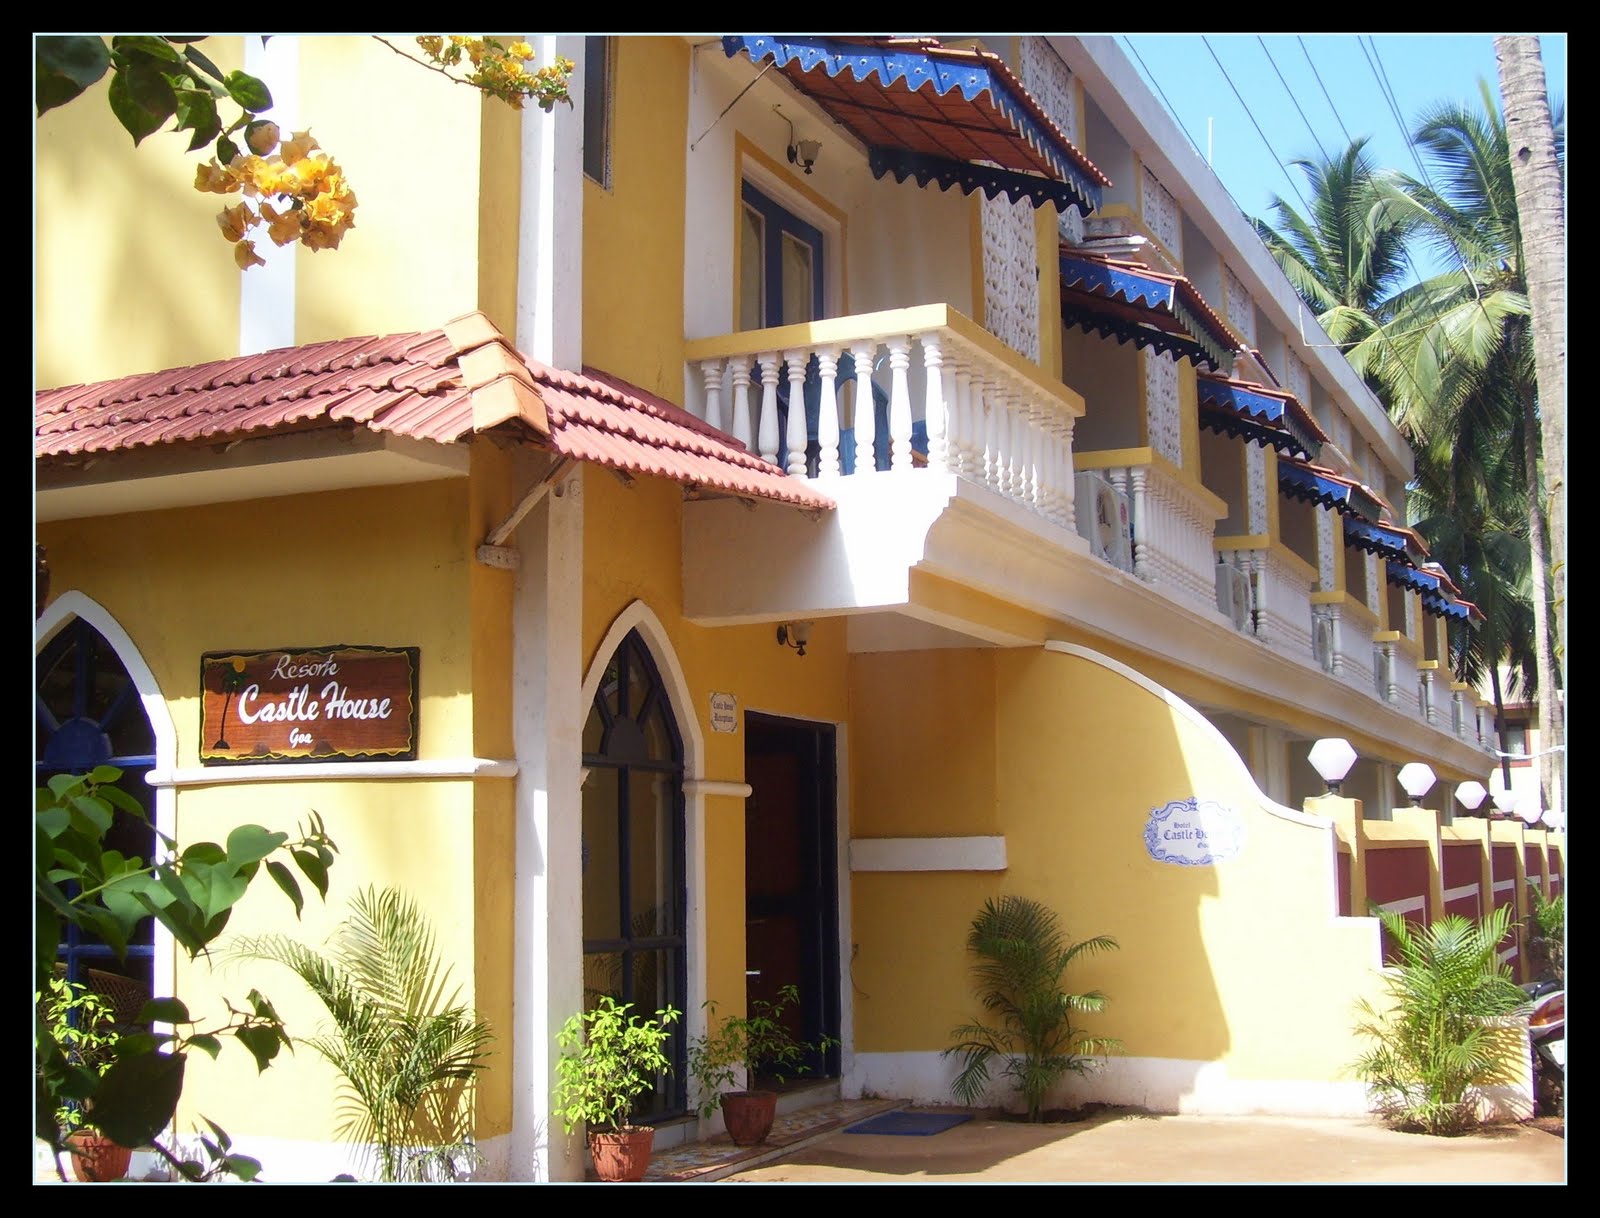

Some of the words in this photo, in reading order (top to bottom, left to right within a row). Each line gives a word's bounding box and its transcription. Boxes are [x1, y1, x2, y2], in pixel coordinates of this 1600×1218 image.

[238, 684, 320, 725] Castle
[321, 681, 393, 720] House
[289, 727, 314, 749] Goa
[1164, 829, 1193, 841] Castle
